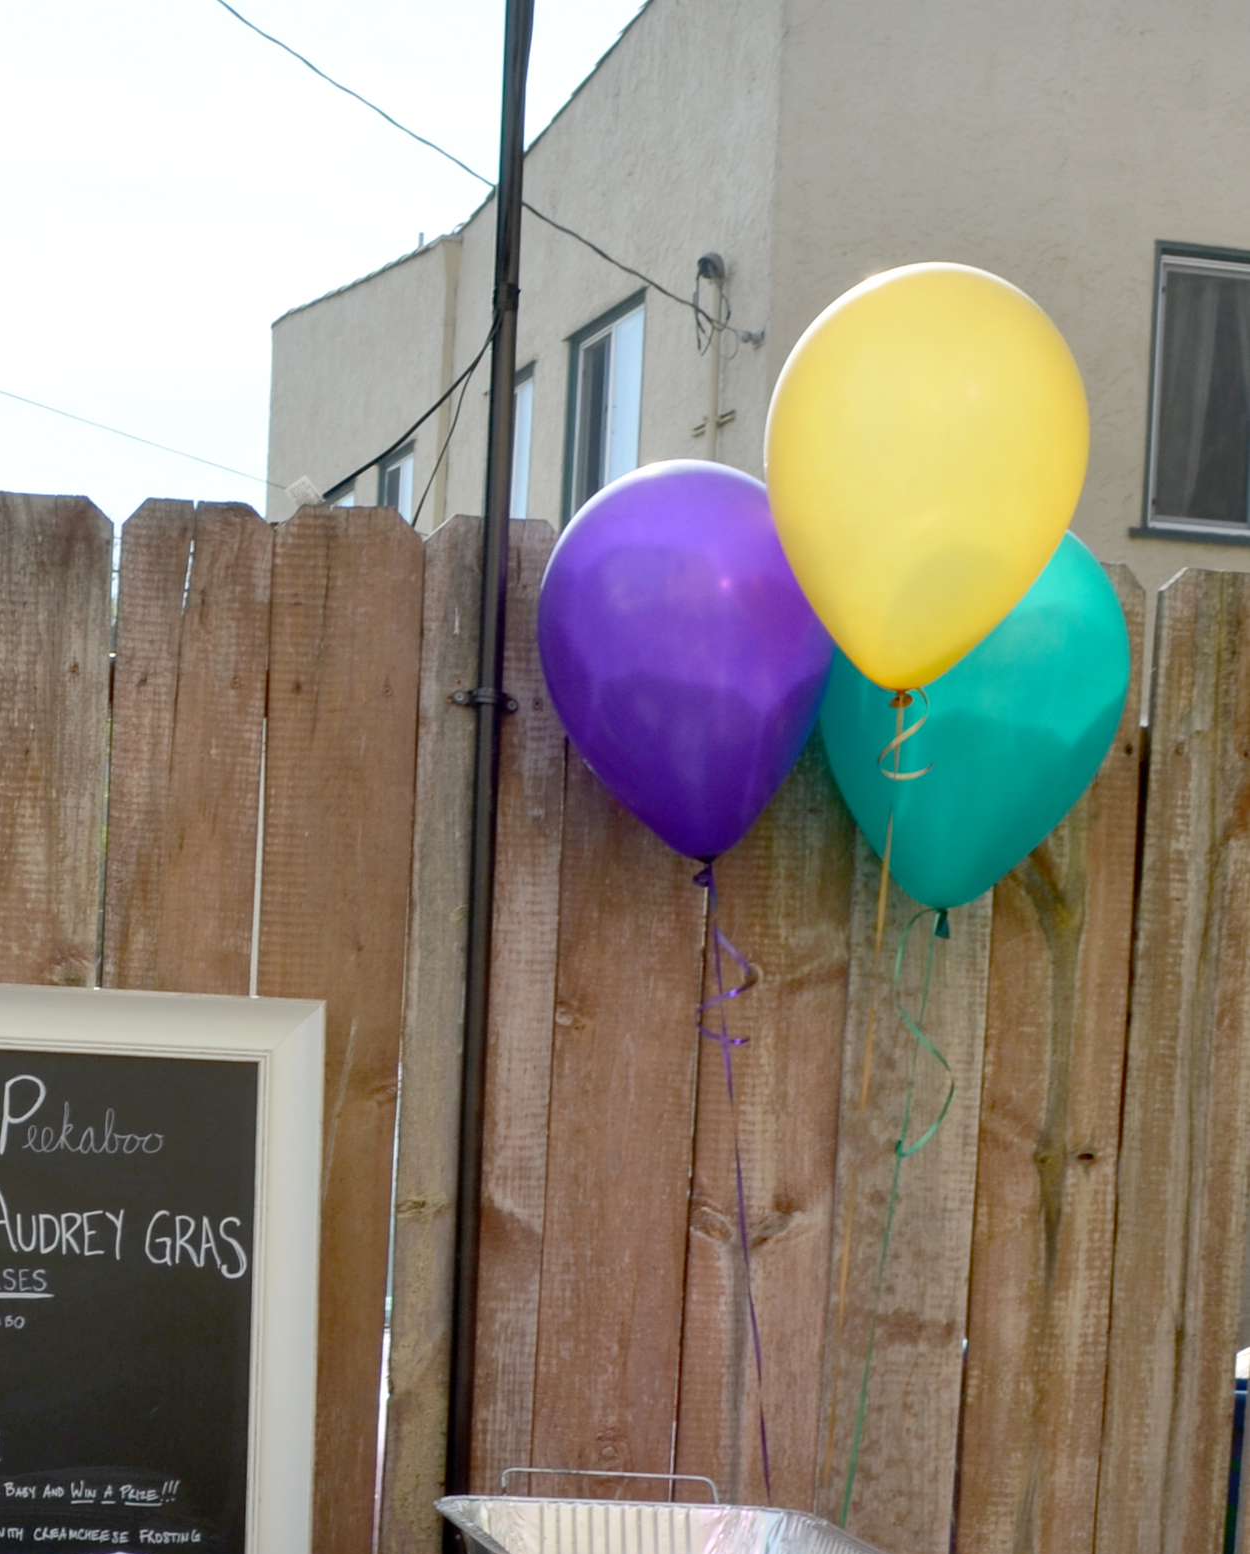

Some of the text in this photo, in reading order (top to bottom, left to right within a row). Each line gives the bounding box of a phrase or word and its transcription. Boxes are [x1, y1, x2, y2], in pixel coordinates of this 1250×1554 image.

[145, 1209, 247, 1278] GRAS
[4, 1482, 37, 1497] BABY
[43, 1484, 65, 1498] AND
[71, 1480, 97, 1499] WIN
[104, 1486, 113, 1498] A
[139, 1529, 201, 1544] FROSTING
